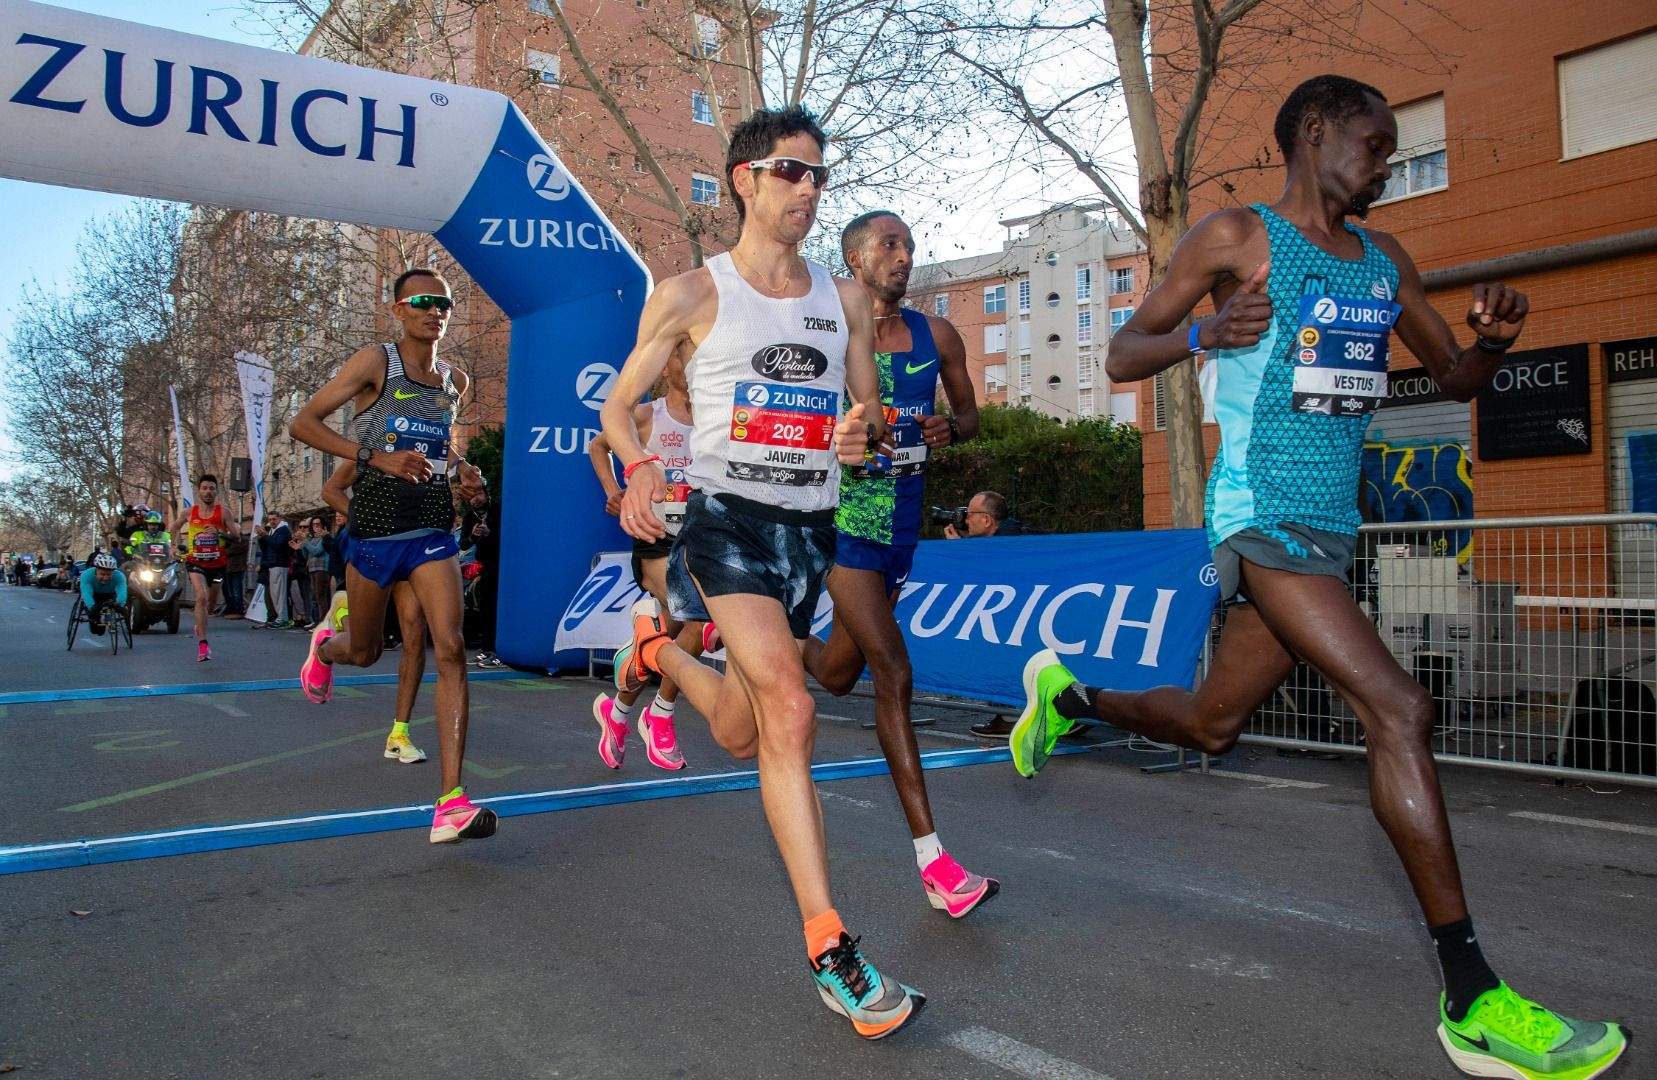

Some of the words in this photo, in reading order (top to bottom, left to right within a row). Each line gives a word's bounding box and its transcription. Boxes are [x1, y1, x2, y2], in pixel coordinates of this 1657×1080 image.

[10, 33, 417, 168] ZURICH
[479, 218, 621, 253] ZURICH
[804, 317, 838, 333] 226ERS
[763, 346, 815, 373] Portada
[1344, 341, 1375, 362] 362
[1334, 375, 1374, 391] VESTUS
[1493, 362, 1569, 391] ORCE
[773, 392, 827, 410] ZURICH
[897, 406, 923, 417] RICH
[411, 422, 444, 436] ZURICH
[660, 431, 684, 442] ada
[772, 424, 805, 440] 202
[414, 442, 428, 454] 30
[765, 450, 806, 464] JAVIER
[892, 452, 910, 461] AYA
